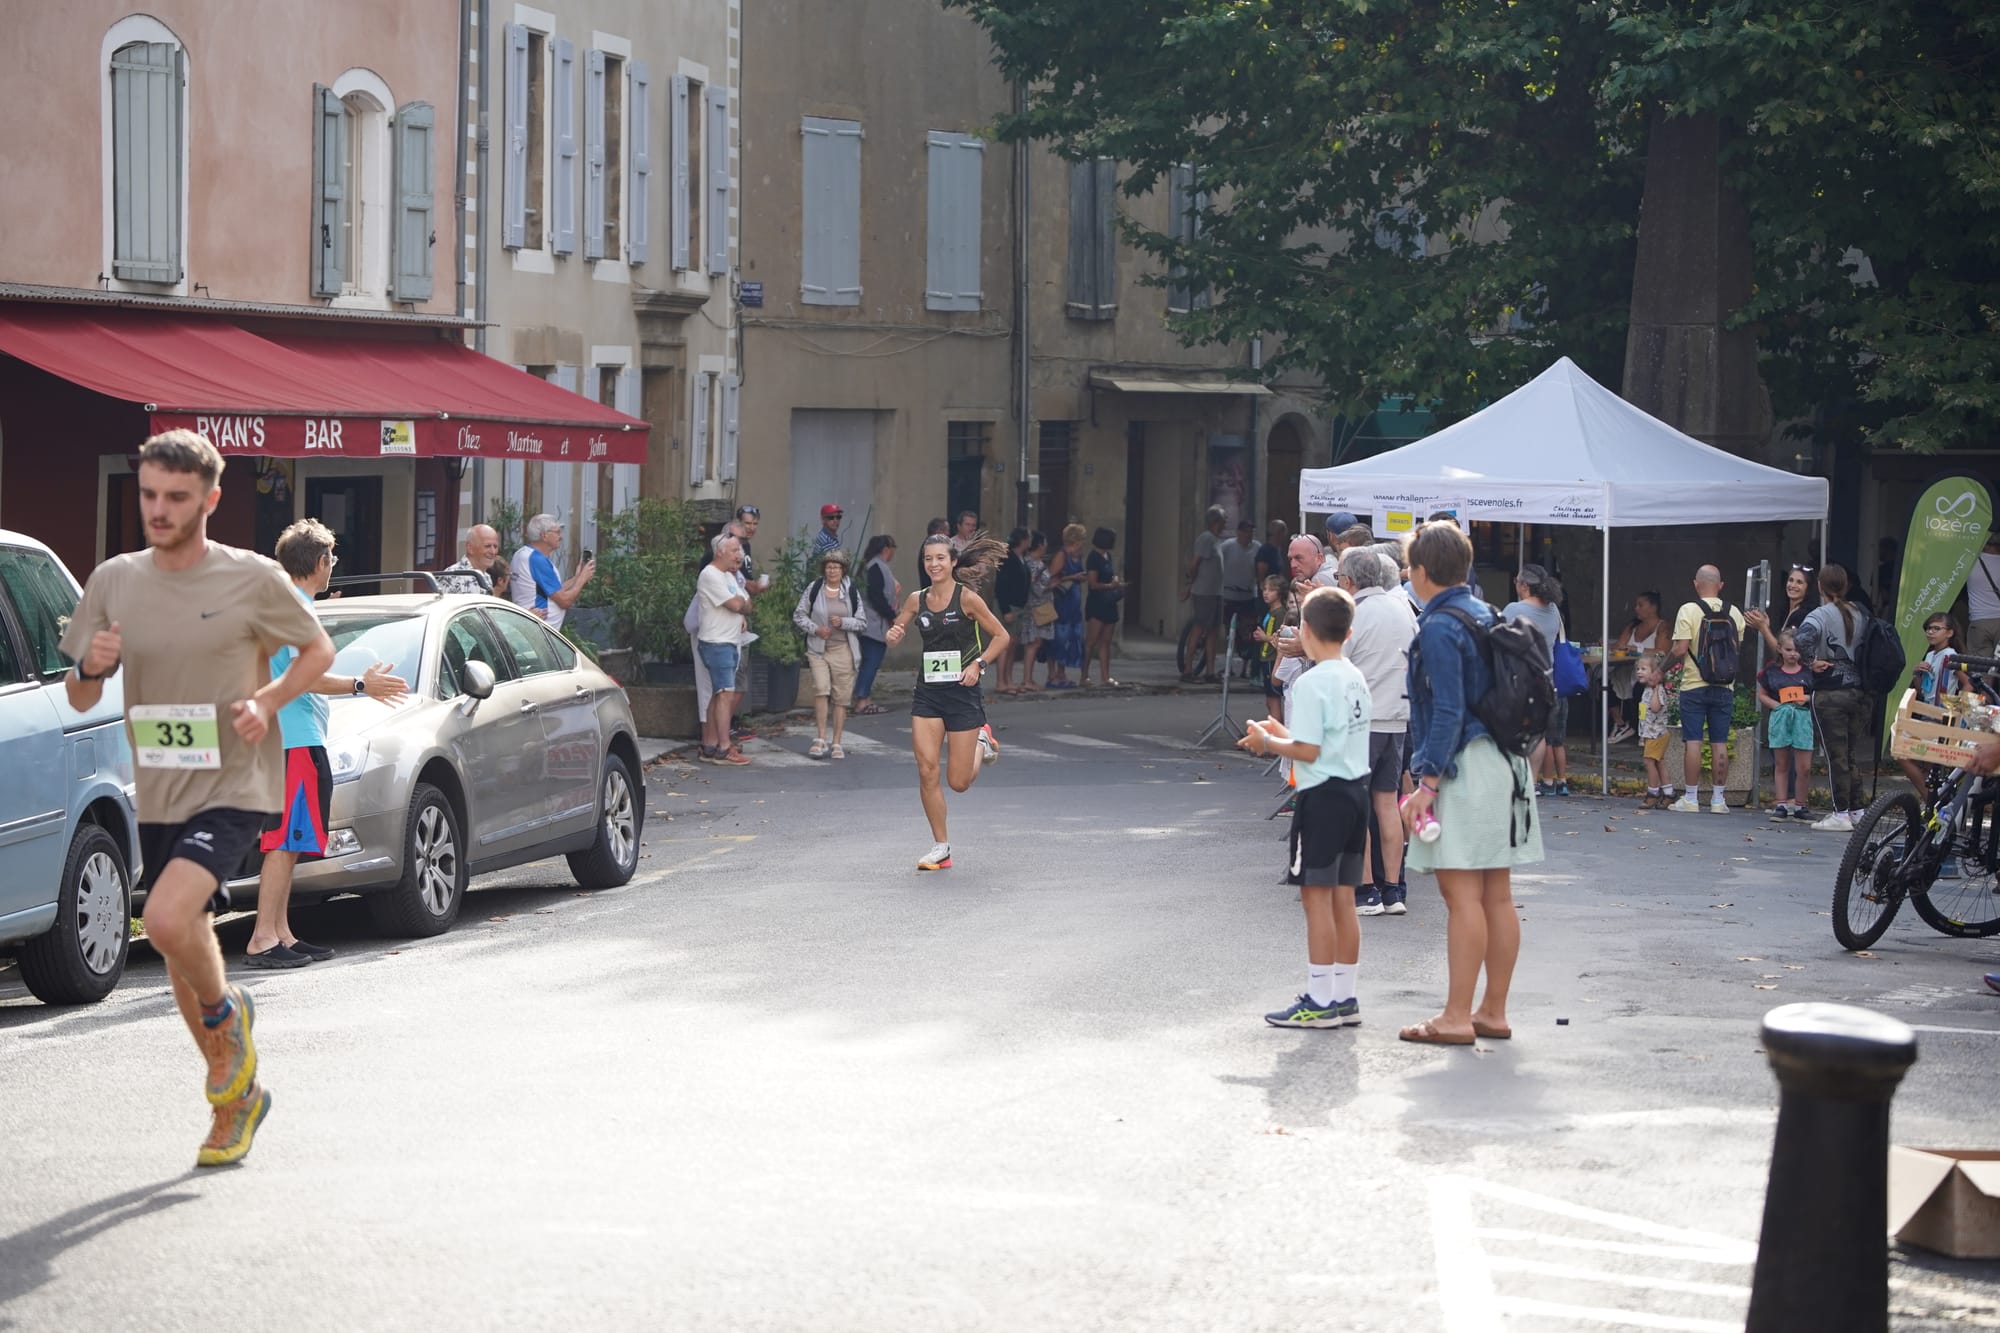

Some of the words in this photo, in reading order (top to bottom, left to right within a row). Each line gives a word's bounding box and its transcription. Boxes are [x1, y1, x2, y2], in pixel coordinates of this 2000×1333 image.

[197, 416, 265, 447] RYAN'S
[305, 419, 343, 448] BAR
[457, 424, 481, 450] Chez
[506, 431, 543, 453] Martine
[560, 437, 569, 455] et
[587, 434, 607, 460] John
[931, 659, 949, 672] 21
[156, 722, 194, 747] 33
